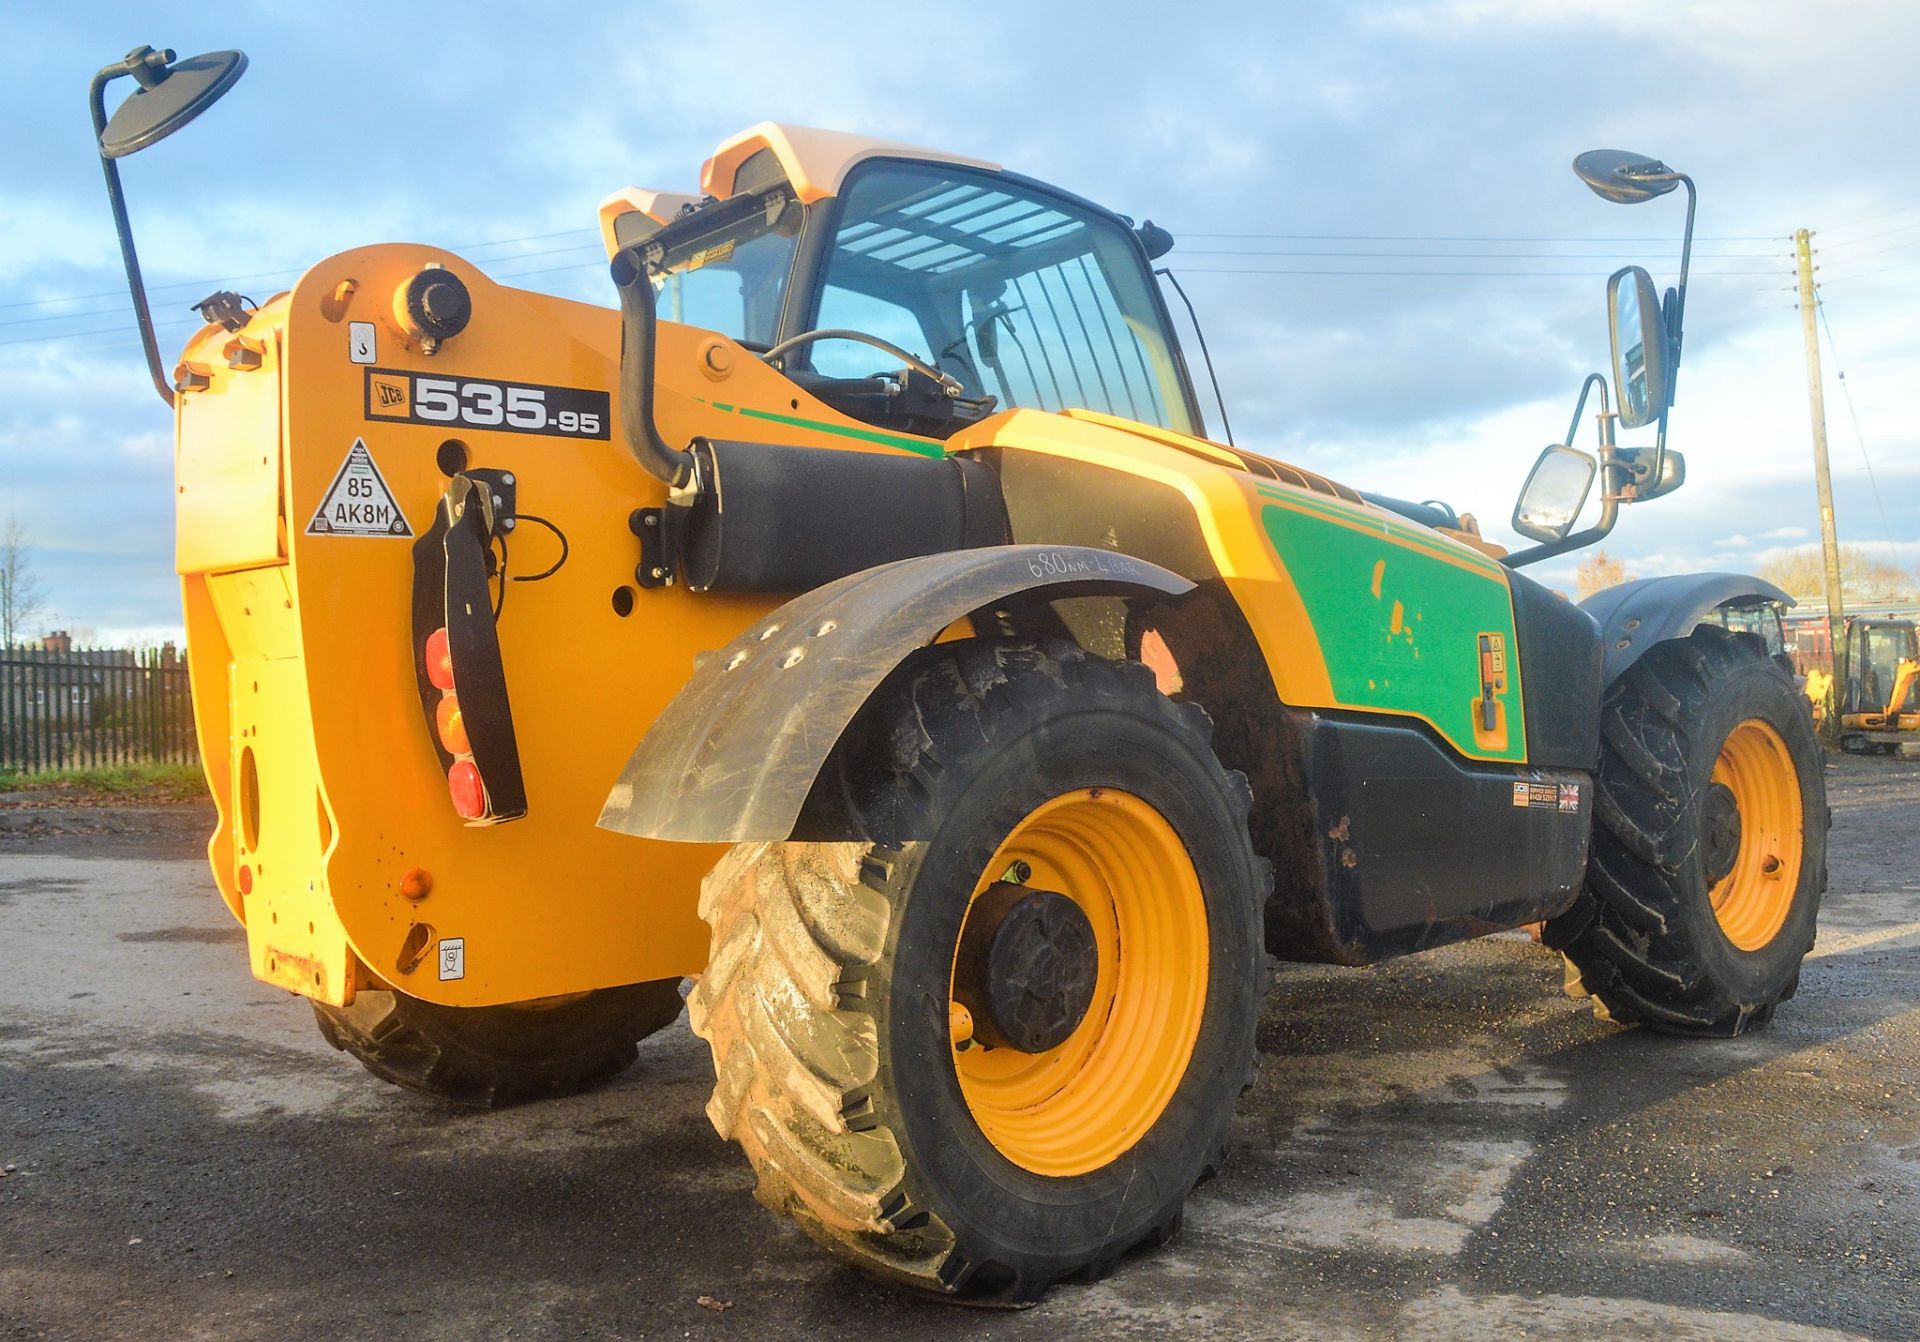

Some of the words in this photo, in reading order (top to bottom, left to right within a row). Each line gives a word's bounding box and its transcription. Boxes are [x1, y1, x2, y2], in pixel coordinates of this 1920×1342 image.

[381, 385, 403, 404] JCB
[348, 478, 373, 498] 85
[335, 503, 389, 525] AK8M
